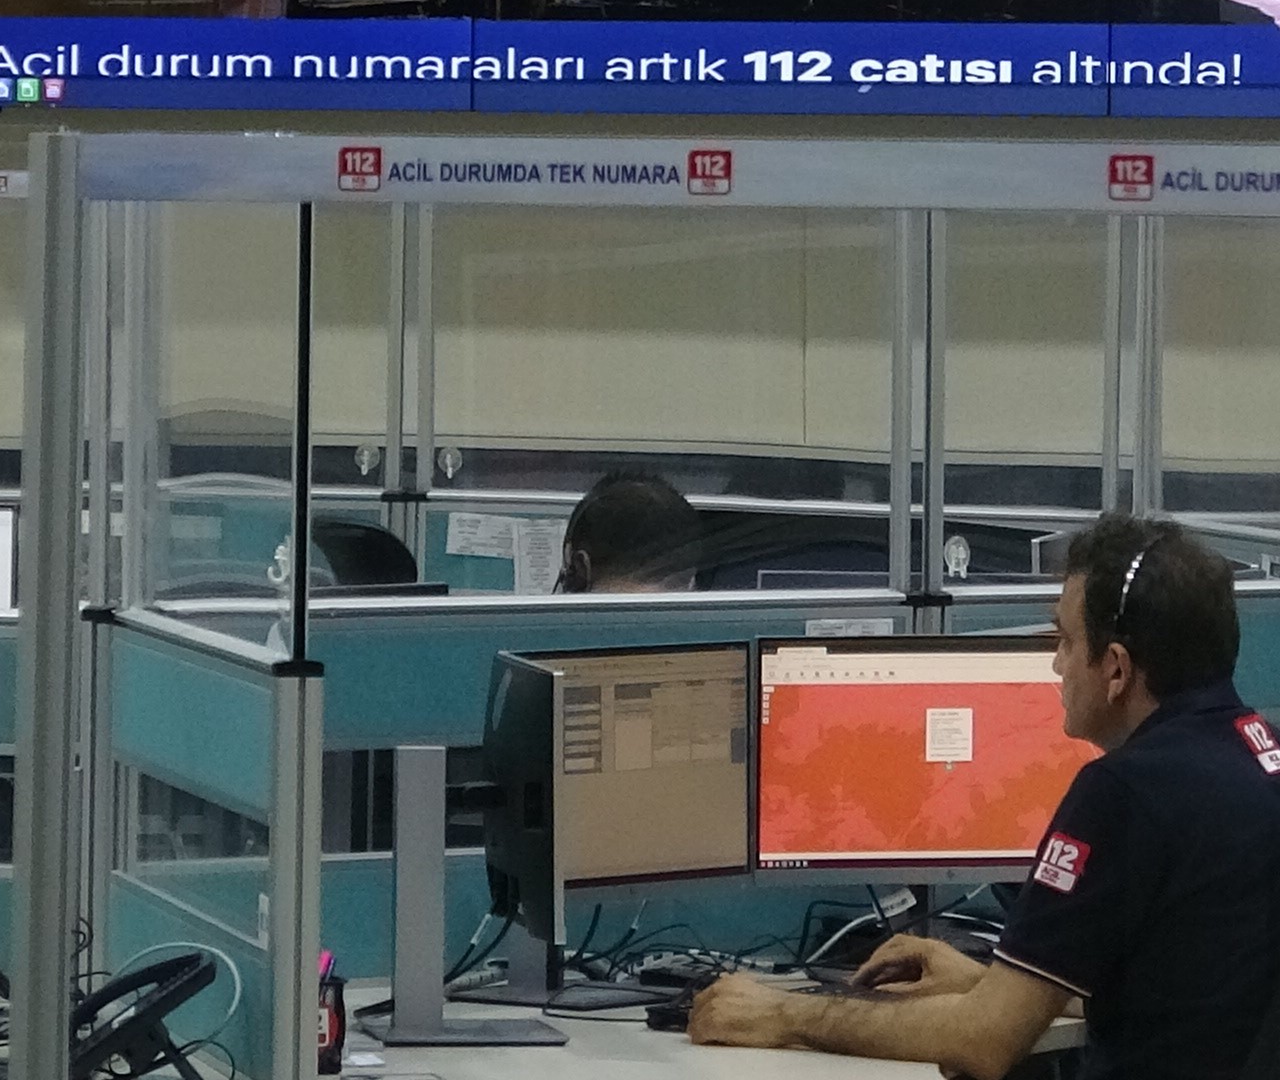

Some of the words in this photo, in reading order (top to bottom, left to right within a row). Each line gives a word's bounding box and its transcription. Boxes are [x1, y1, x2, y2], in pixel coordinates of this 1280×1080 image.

[99, 44, 272, 78] durum
[294, 47, 584, 80] numaraları
[606, 48, 727, 81] artık
[743, 51, 833, 82] 112
[849, 53, 1012, 93] çatısı
[1032, 51, 1241, 85] altında!
[345, 152, 374, 174] 112
[388, 158, 433, 182] ACİL
[440, 163, 541, 183] DURUMDA
[547, 163, 586, 184] TEK
[593, 164, 681, 184] NUMARA
[694, 155, 723, 177] 112
[1115, 160, 1146, 182] 112
[1160, 167, 1208, 191] ACİL
[1243, 721, 1274, 752] 112
[1042, 837, 1079, 871] 112
